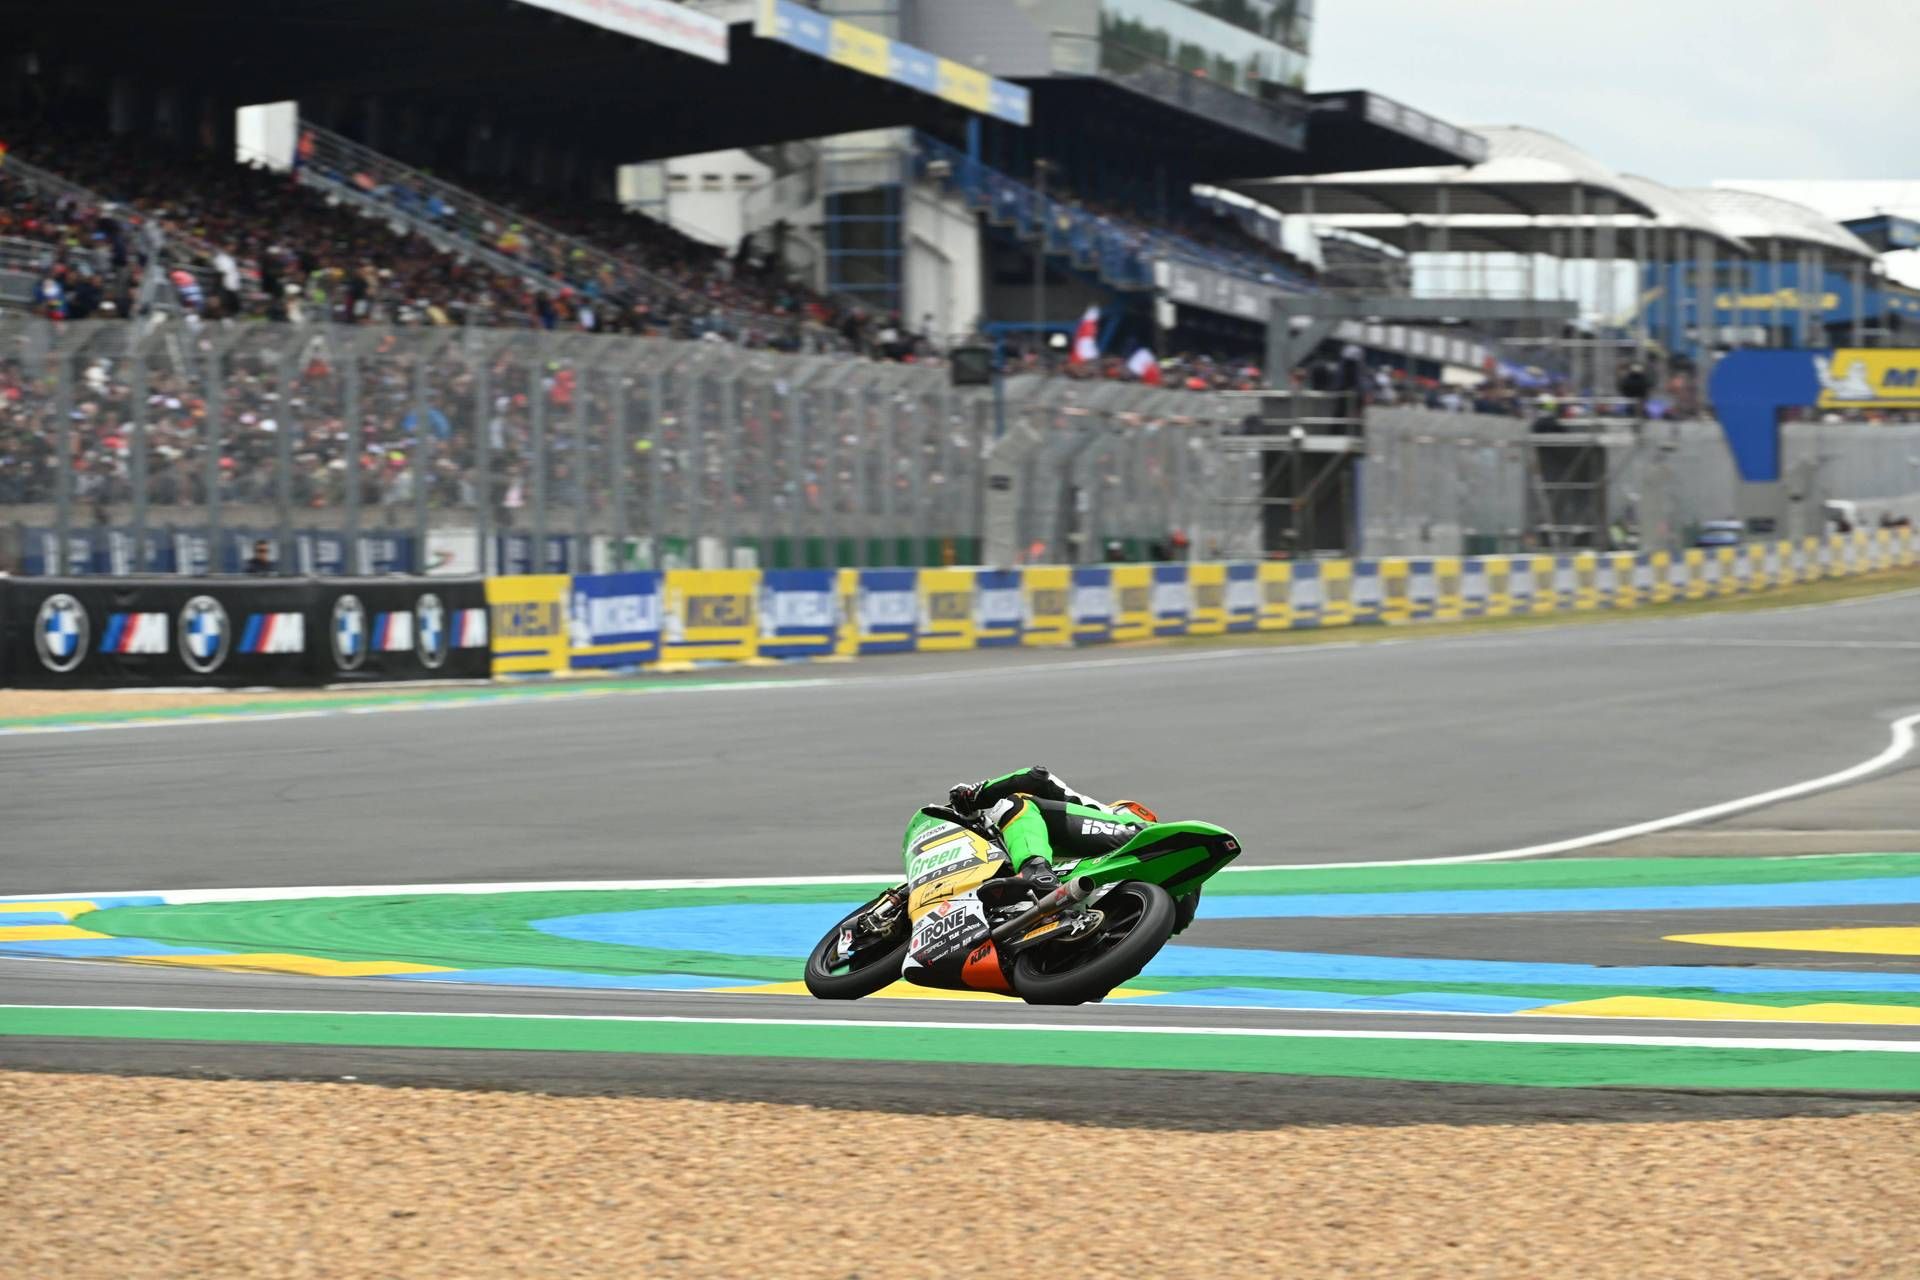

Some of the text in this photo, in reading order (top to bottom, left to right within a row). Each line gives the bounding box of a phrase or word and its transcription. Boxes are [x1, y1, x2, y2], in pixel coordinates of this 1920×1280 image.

[912, 846, 962, 877] Green
[921, 909, 964, 947] IPONE
[970, 944, 992, 965] KTM
